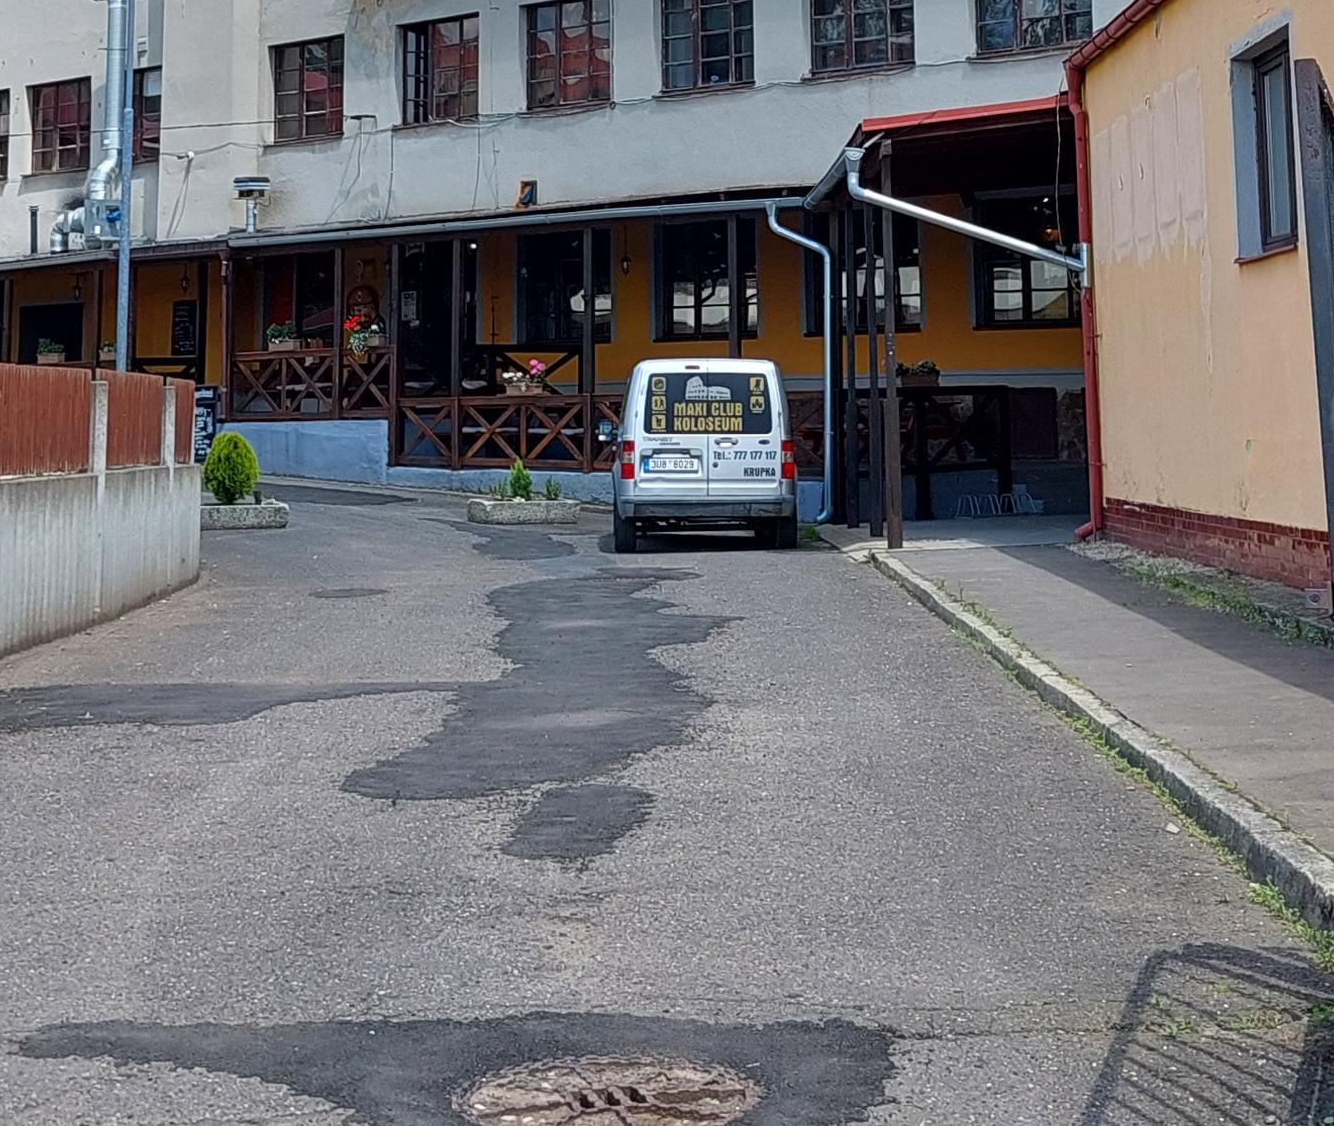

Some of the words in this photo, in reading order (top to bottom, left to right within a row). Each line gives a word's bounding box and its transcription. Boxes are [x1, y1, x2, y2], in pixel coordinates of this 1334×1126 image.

[673, 402, 708, 416] MAXI
[711, 402, 743, 416] CLUB
[673, 417, 743, 431] KOLOSEUM
[733, 450, 748, 460] 777
[750, 450, 763, 460] 177
[765, 450, 778, 460] 117
[743, 467, 776, 477] KRUPKA
